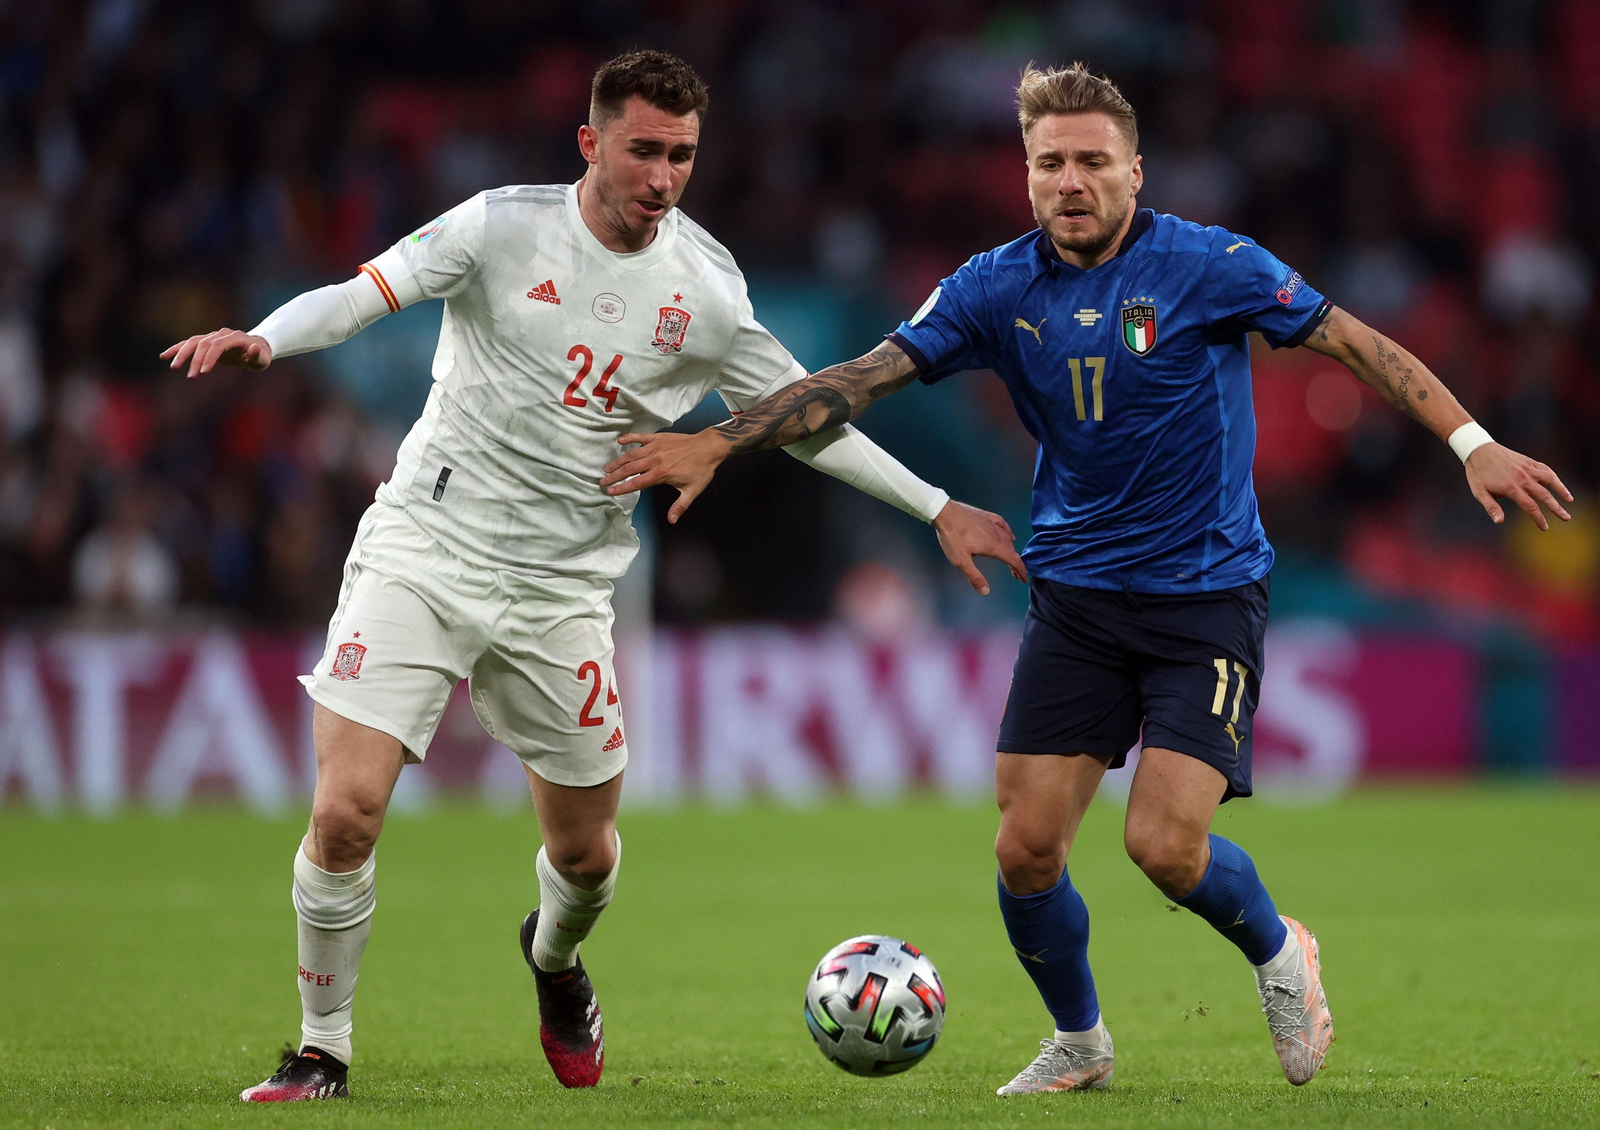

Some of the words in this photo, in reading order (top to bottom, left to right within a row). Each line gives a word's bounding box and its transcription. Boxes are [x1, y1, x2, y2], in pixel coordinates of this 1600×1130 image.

[526, 291, 561, 305] adidas
[1124, 308, 1153, 319] ITALIA
[562, 344, 624, 413] 24
[1067, 357, 1106, 421] 17
[1211, 658, 1250, 724] 17
[298, 965, 336, 986] RFEF
